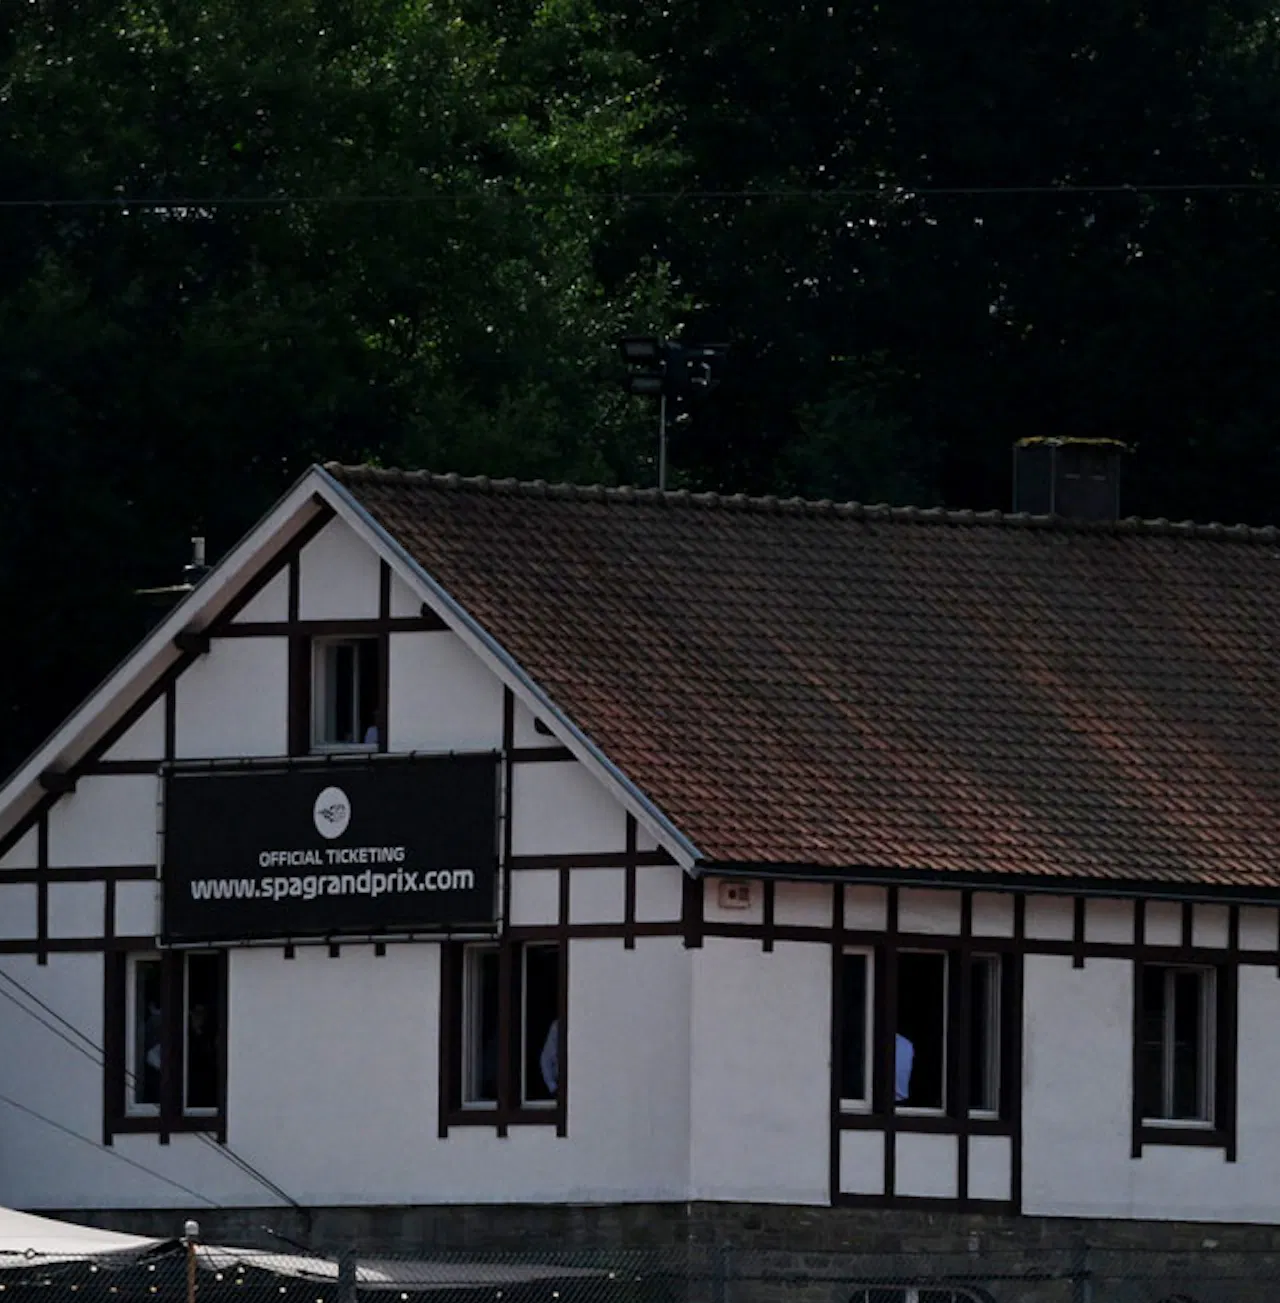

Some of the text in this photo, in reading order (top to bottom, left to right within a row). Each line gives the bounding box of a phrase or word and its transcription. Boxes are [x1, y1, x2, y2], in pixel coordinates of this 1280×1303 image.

[258, 846, 405, 868] OFFICIAL TICKETING
[190, 869, 474, 901] www.spagrandprix.com
